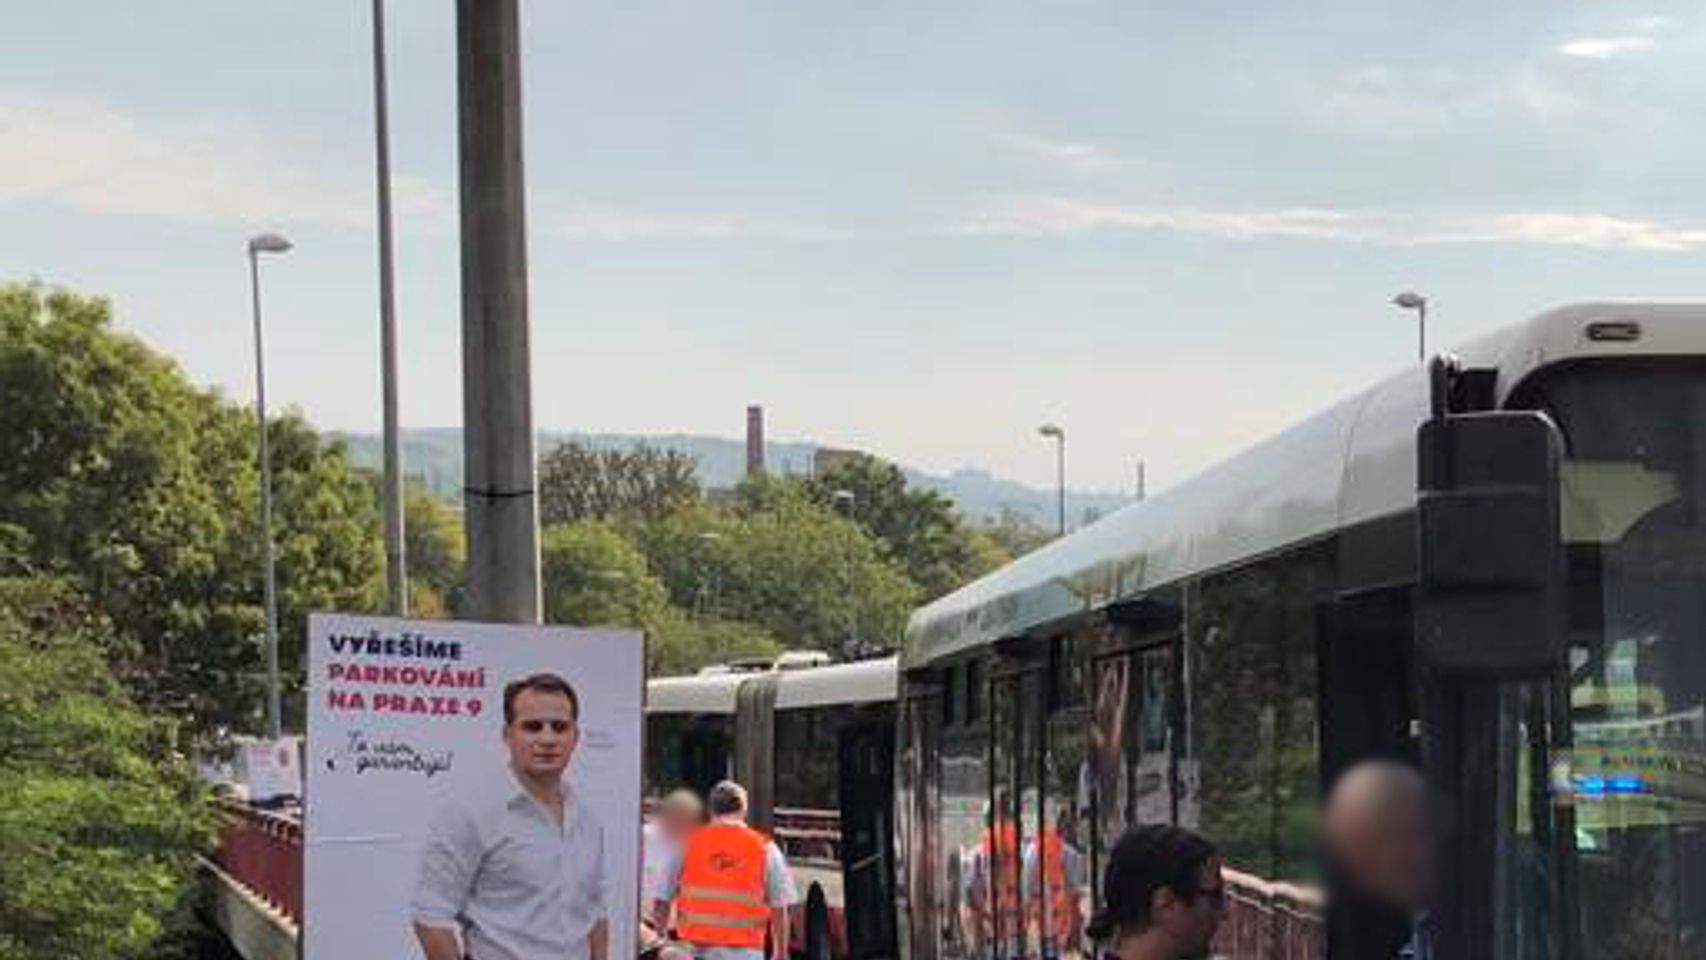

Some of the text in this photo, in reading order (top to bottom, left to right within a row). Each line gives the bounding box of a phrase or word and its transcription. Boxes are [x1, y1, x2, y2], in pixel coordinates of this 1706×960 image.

[328, 630, 462, 660] VYŘEŠÍME
[328, 663, 485, 688] PARKOVÁNÍ
[328, 690, 482, 716] NA PRAZE 9
